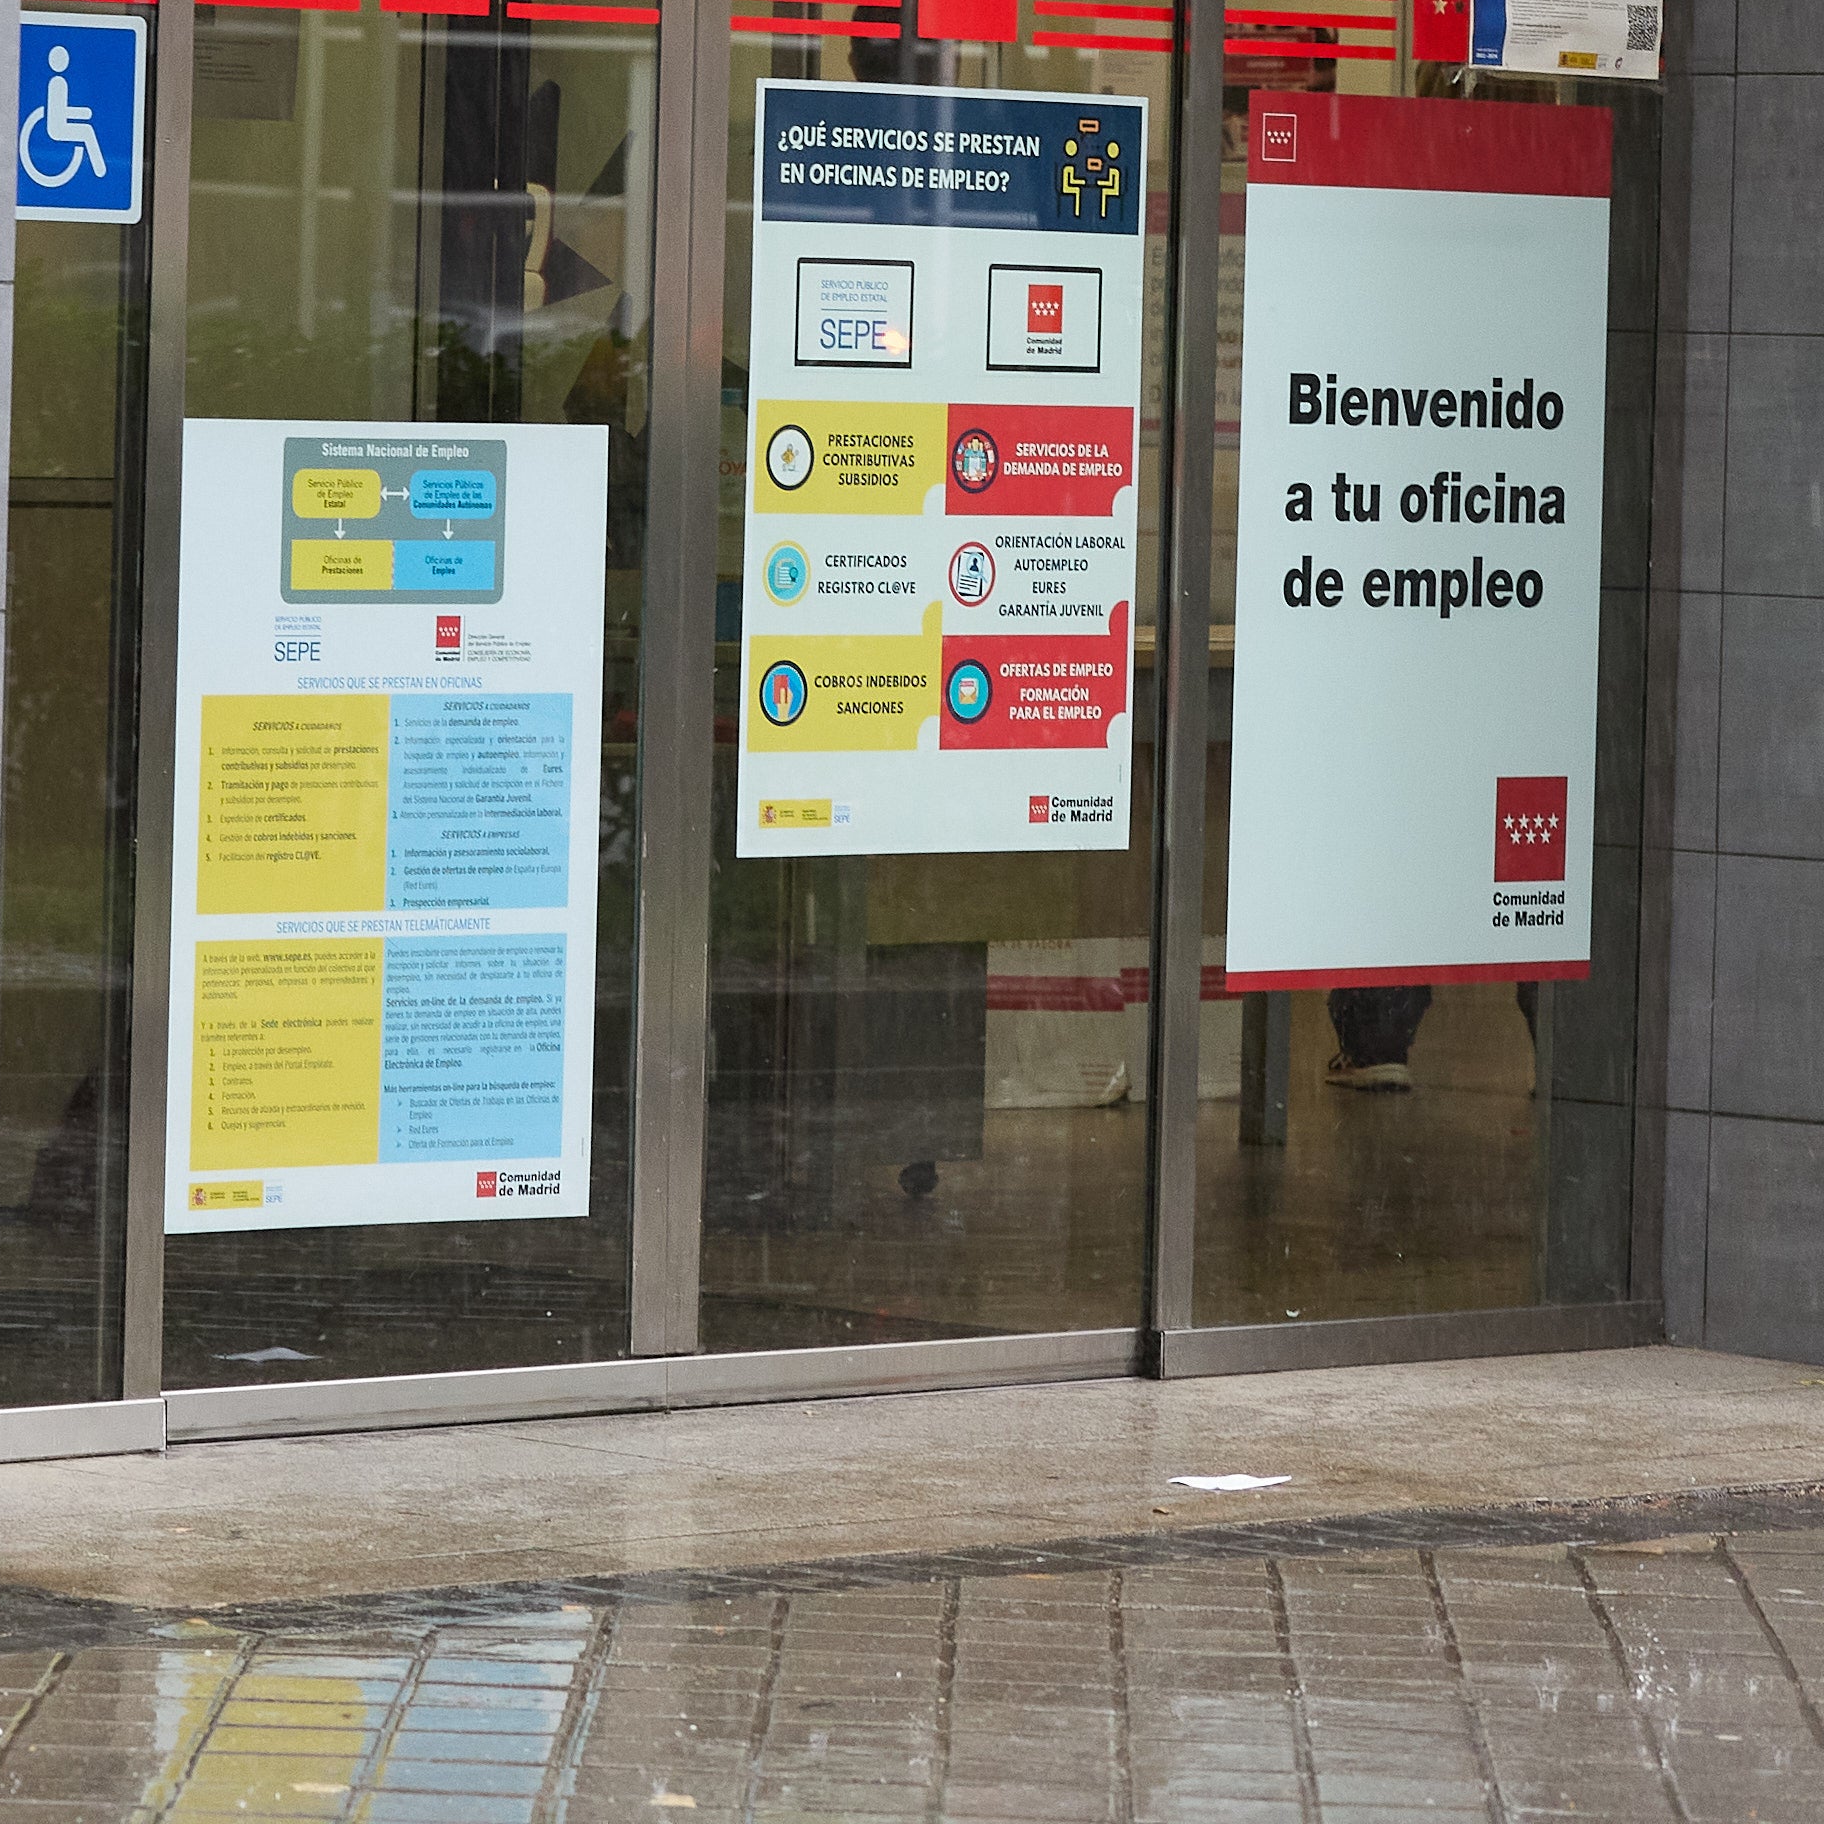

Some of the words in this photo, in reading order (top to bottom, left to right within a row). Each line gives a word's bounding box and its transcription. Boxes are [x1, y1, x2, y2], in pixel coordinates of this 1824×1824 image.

[778, 121, 826, 151] ¿QUÉ
[831, 127, 928, 151] SERVICIOS
[932, 132, 954, 152] SE
[959, 133, 1040, 156] PRESTAN
[780, 163, 805, 184] EN
[809, 164, 897, 187] OFICINAS
[902, 167, 924, 188] DE
[929, 169, 1010, 192] EMPLEO?
[821, 280, 854, 290] SERVICIO
[821, 292, 830, 301] DE
[832, 293, 859, 302] EMPLEO
[861, 293, 887, 303] ESTATAL
[820, 318, 887, 350] SEPE
[1026, 337, 1062, 345] Comunidad
[1026, 346, 1035, 354] de
[1037, 346, 1062, 355] Madrid
[1288, 371, 1565, 431] Bienvenido
[828, 435, 914, 448] PRESTACIONES
[322, 443, 363, 457] Sistema
[367, 444, 412, 457] Nacional
[416, 444, 428, 458] de
[432, 444, 469, 460] Empleo
[1016, 443, 1075, 457] SERVICIOS
[1078, 445, 1092, 457] DE
[1094, 446, 1109, 458] LA
[823, 453, 915, 467] CONTRIBUTIVAS
[1004, 462, 1059, 476] DEMANDA
[1062, 463, 1076, 476] DE
[1079, 463, 1123, 477] EMPLEO
[308, 479, 334, 488] Servicio
[337, 479, 363, 488] Público
[422, 480, 453, 489] Servicios
[455, 479, 484, 489] Públicos
[838, 473, 899, 486] SUBSIDIOS
[317, 490, 325, 498] de
[328, 490, 353, 500] Empleo
[1284, 482, 1313, 523] a
[1332, 472, 1381, 524] tu
[1400, 471, 1565, 526] oficina
[324, 500, 346, 508] Estatal
[995, 532, 1073, 549] ORIENTACIÓN
[1075, 536, 1126, 549] LABORAL
[324, 556, 350, 564] Oficinas
[352, 556, 362, 564] de
[425, 556, 452, 565] Oficinas
[454, 557, 463, 565] de
[825, 555, 907, 568] CERTIFICADOS
[1014, 559, 1089, 572] AUTOEMPLEO
[322, 566, 363, 575] Prestaciones
[432, 566, 456, 576] Empleo
[818, 581, 874, 594] REGISTRO
[878, 581, 916, 595] CL@VE
[1032, 581, 1066, 594] EURES
[1282, 556, 1343, 610] de
[1363, 556, 1544, 619] empleo
[999, 600, 1057, 617] GARANTÍA
[1059, 604, 1104, 617] JUVENIL
[274, 641, 321, 662] SEPE
[1000, 663, 1050, 678] OFERTAS
[1053, 664, 1067, 677] DE
[1069, 663, 1113, 677] EMPLEO
[298, 677, 345, 689] SERVICIOS
[346, 677, 366, 689] QUE
[369, 677, 380, 688] SE
[383, 677, 423, 688] PRESTAN
[426, 677, 437, 688] EN
[440, 677, 482, 688] OFICINAS
[815, 675, 862, 688] COBROS
[866, 675, 927, 688] INDEBIDOS
[1020, 684, 1089, 702] FORMACIÓN
[837, 702, 904, 715] SANCIONES
[1009, 706, 1040, 720] PARA
[1042, 706, 1055, 719] EL
[1058, 706, 1102, 720] EMPLEO
[1051, 796, 1114, 808] Comunidad
[1051, 810, 1066, 822] de
[1070, 809, 1113, 822] Madrid
[1493, 890, 1565, 908] Comunidad
[1492, 910, 1511, 928] de
[1514, 908, 1565, 928] Madrid
[276, 921, 324, 934] SERVICIOS
[326, 920, 346, 933] QUE
[347, 920, 358, 932] SE
[361, 919, 402, 932] PRESTAN
[405, 917, 491, 931] TELEMÁTICAMENTE
[499, 1171, 561, 1182] Comunidad
[499, 1186, 514, 1196] de
[518, 1184, 560, 1196] Madrid
